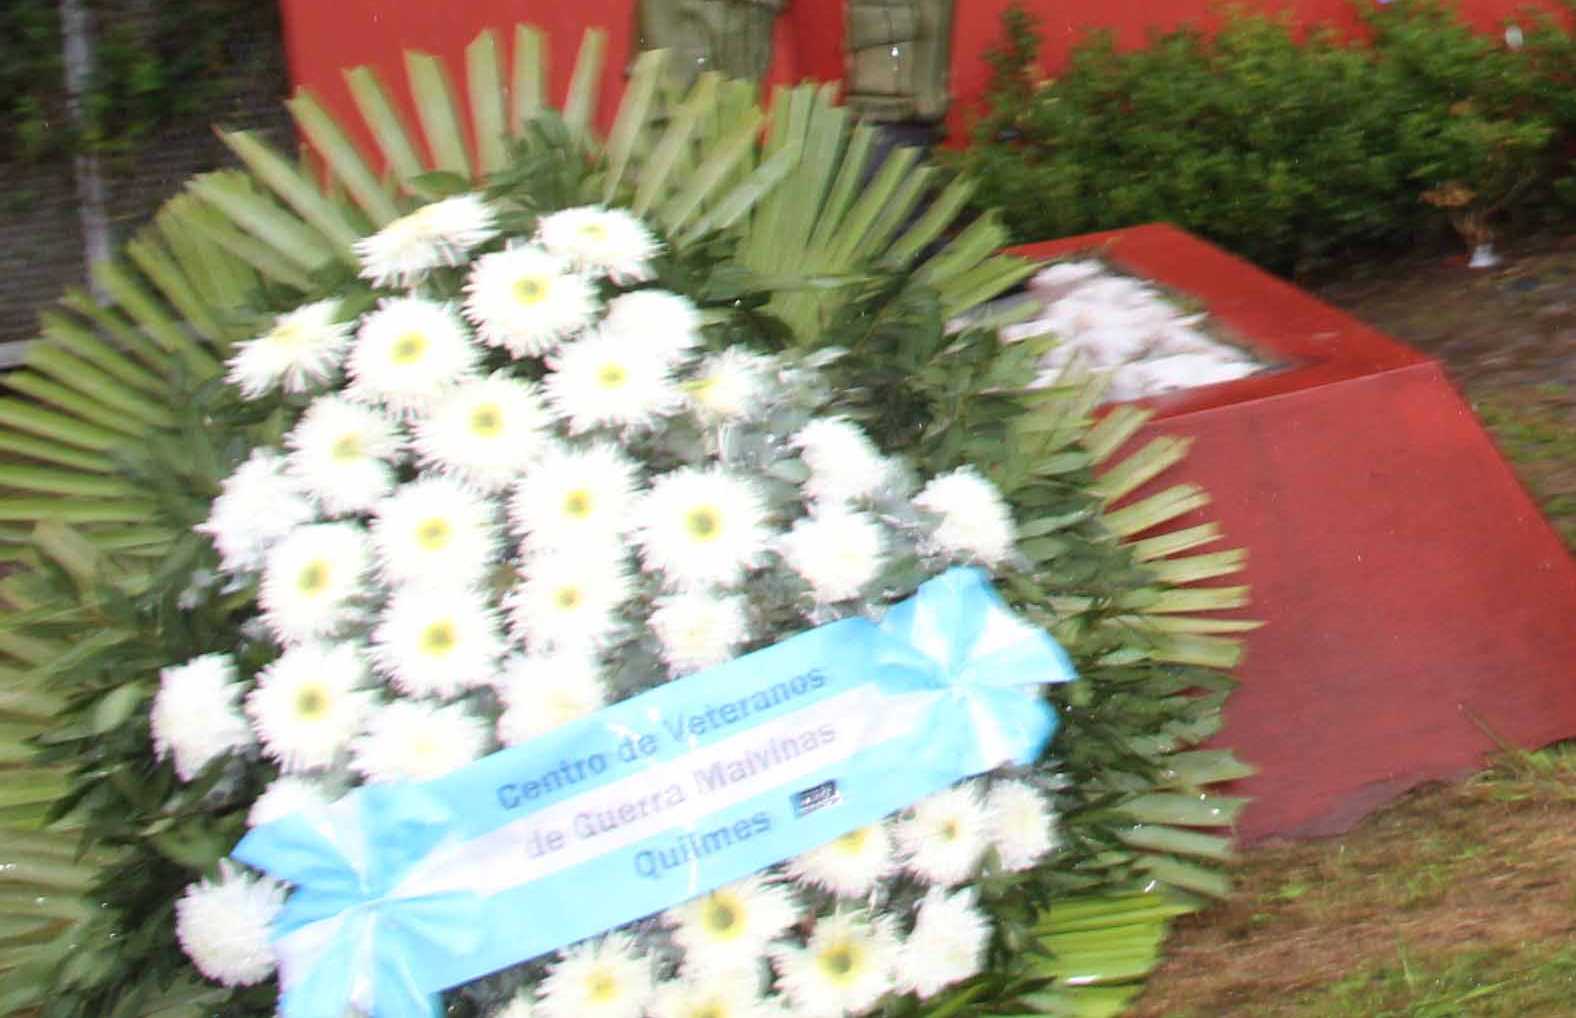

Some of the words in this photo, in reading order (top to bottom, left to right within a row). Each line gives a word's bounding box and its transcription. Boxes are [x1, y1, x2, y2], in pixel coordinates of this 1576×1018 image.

[498, 752, 608, 811] Centro
[619, 731, 659, 763] de
[666, 667, 827, 742] Veteranos
[529, 829, 566, 858] de
[572, 786, 686, 839] Guerra
[697, 722, 837, 791] Malvinas
[634, 812, 772, 878] Quilmes
